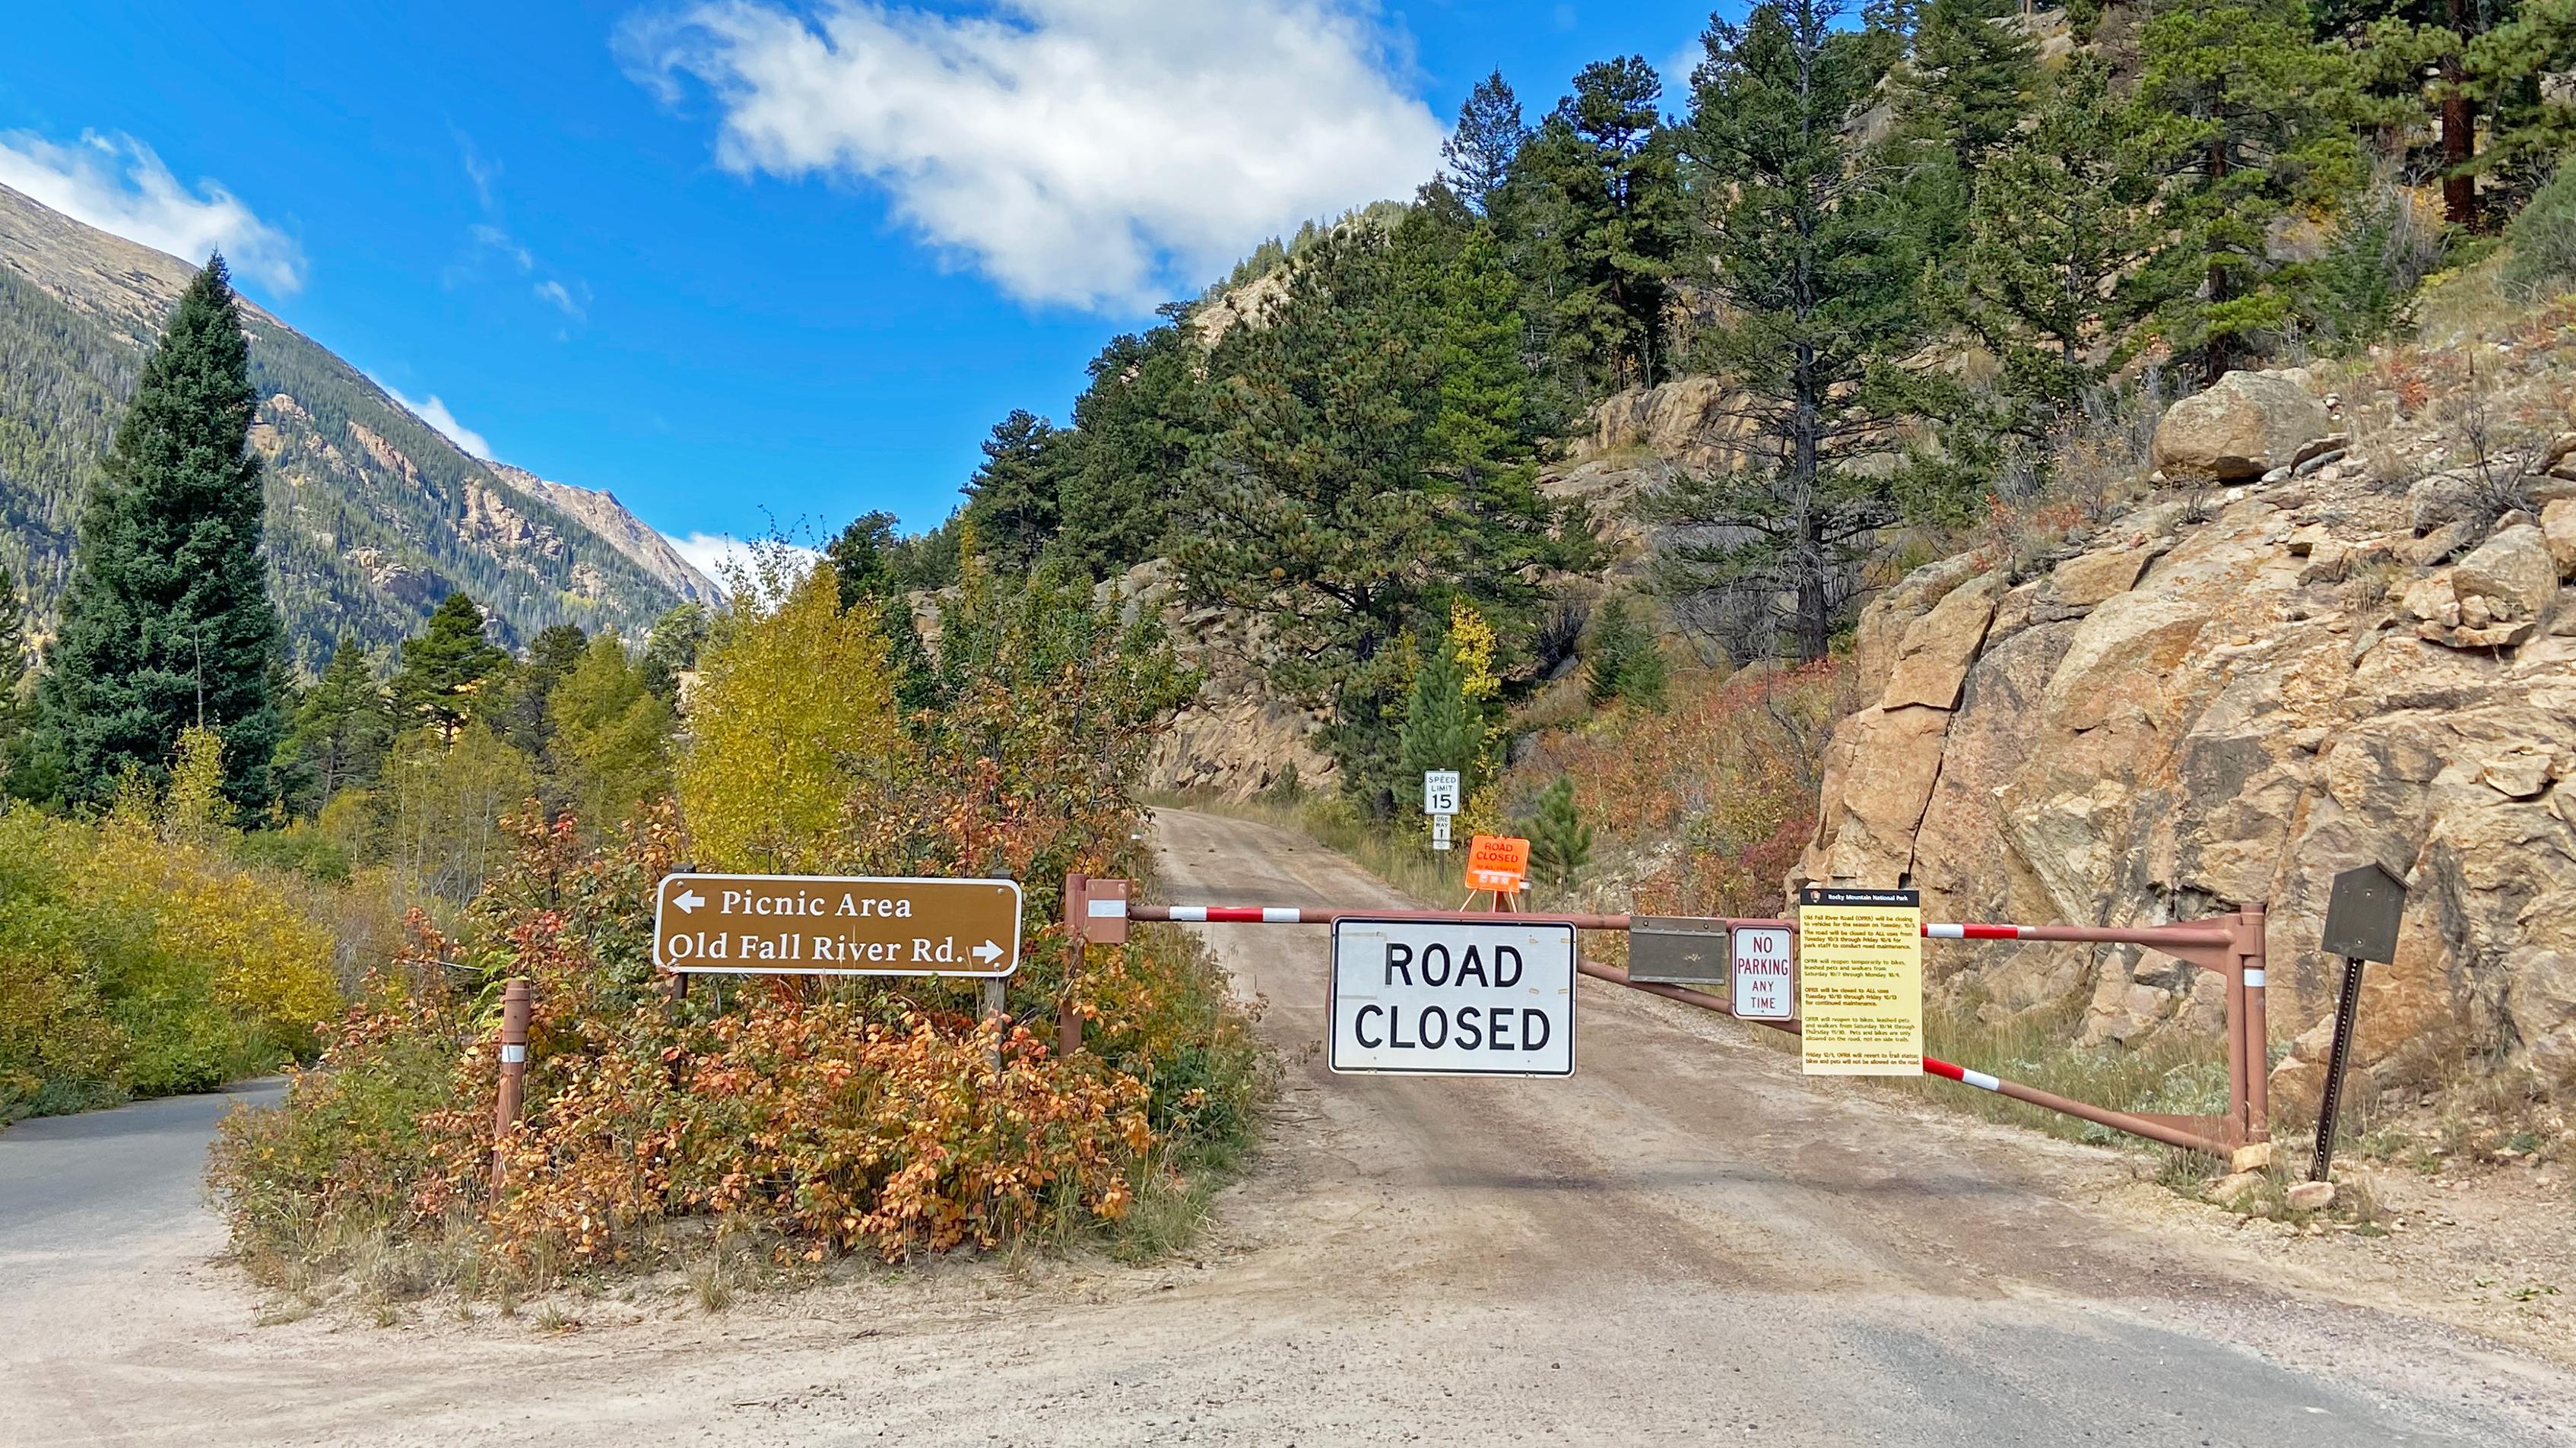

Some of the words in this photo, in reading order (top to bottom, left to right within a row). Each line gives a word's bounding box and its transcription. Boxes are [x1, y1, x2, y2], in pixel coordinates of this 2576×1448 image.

[1432, 794, 1451, 809] 15
[1485, 842, 1512, 852] ROAD
[1477, 852, 1518, 863] CLOSED
[721, 890, 825, 917] Picnic
[835, 892, 912, 918] Area
[668, 931, 728, 960] Old
[740, 933, 801, 960] Fall
[811, 934, 901, 962] River
[912, 936, 963, 963] Rd.
[1753, 936, 1772, 953] NO
[1385, 943, 1522, 987] ROAD
[1738, 958, 1788, 976] PARKING
[1752, 981, 1774, 992] ANY
[1751, 997, 1775, 1009] TIME
[1355, 1004, 1550, 1051] CLOSED
